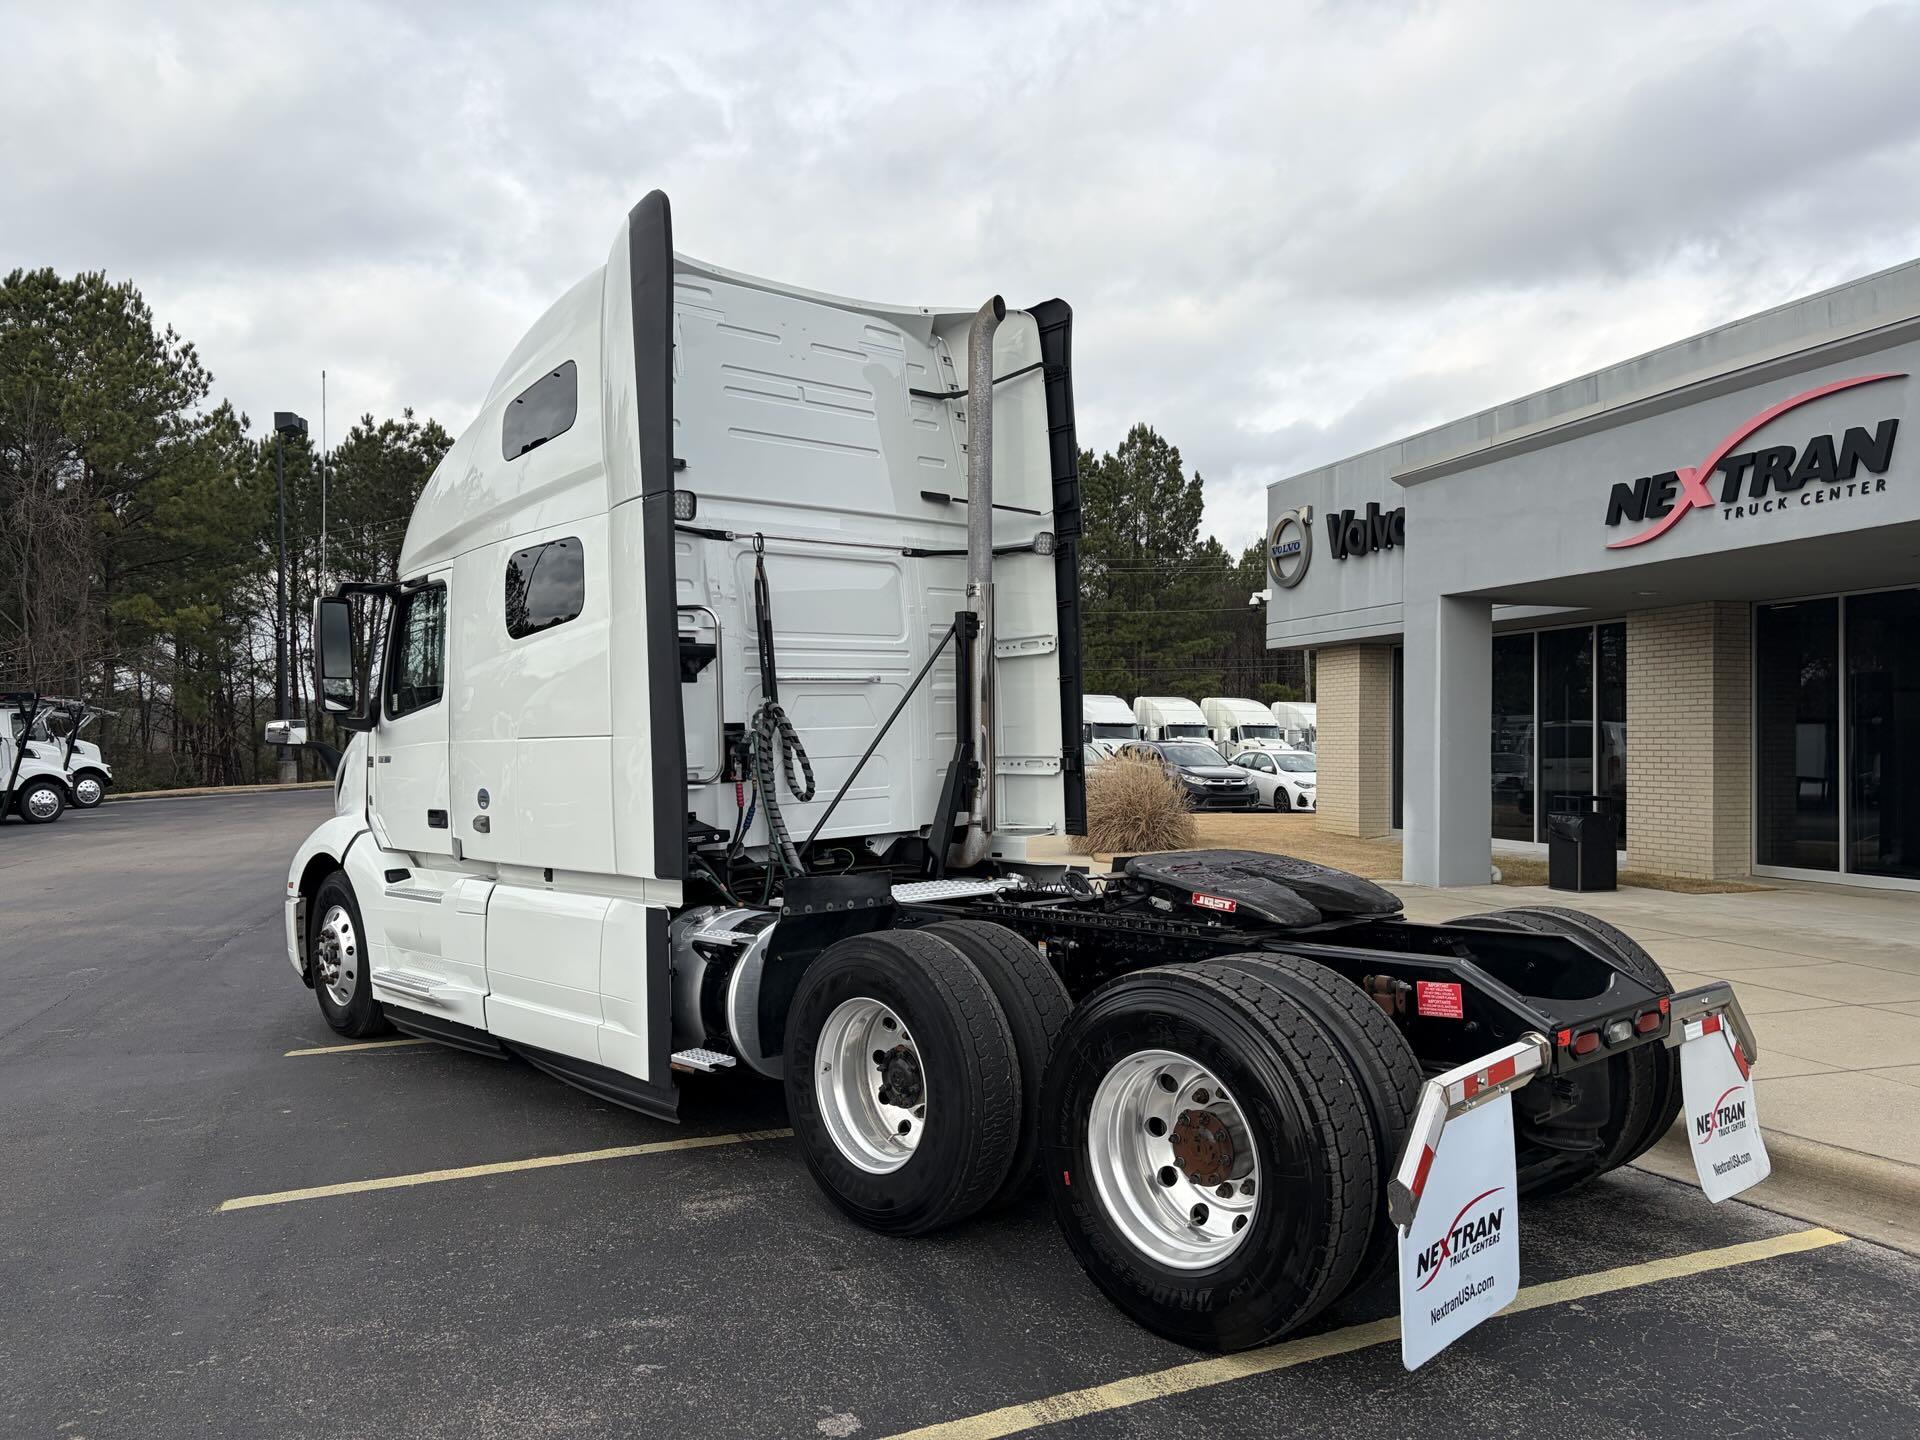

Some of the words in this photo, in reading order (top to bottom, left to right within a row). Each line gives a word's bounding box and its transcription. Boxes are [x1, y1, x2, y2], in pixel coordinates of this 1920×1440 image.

[1605, 418, 1900, 526] NEXTRAN
[1723, 496, 1788, 520] TRUCK
[1800, 478, 1887, 506] CENTER
[1272, 541, 1300, 555] VOLVO
[1196, 895, 1232, 910] JOST
[1696, 1101, 1746, 1136] NEXTRAN
[1718, 1126, 1731, 1138] TRUCK
[1731, 1119, 1747, 1133] CENTERS
[1712, 1152, 1752, 1176] NextranUSA.com
[1416, 1208, 1504, 1279] NEXTRAN
[1450, 1247, 1470, 1268] TRUCK
[1471, 1232, 1501, 1255] CENTERS
[1430, 1275, 1495, 1326] NextranUSA.com
